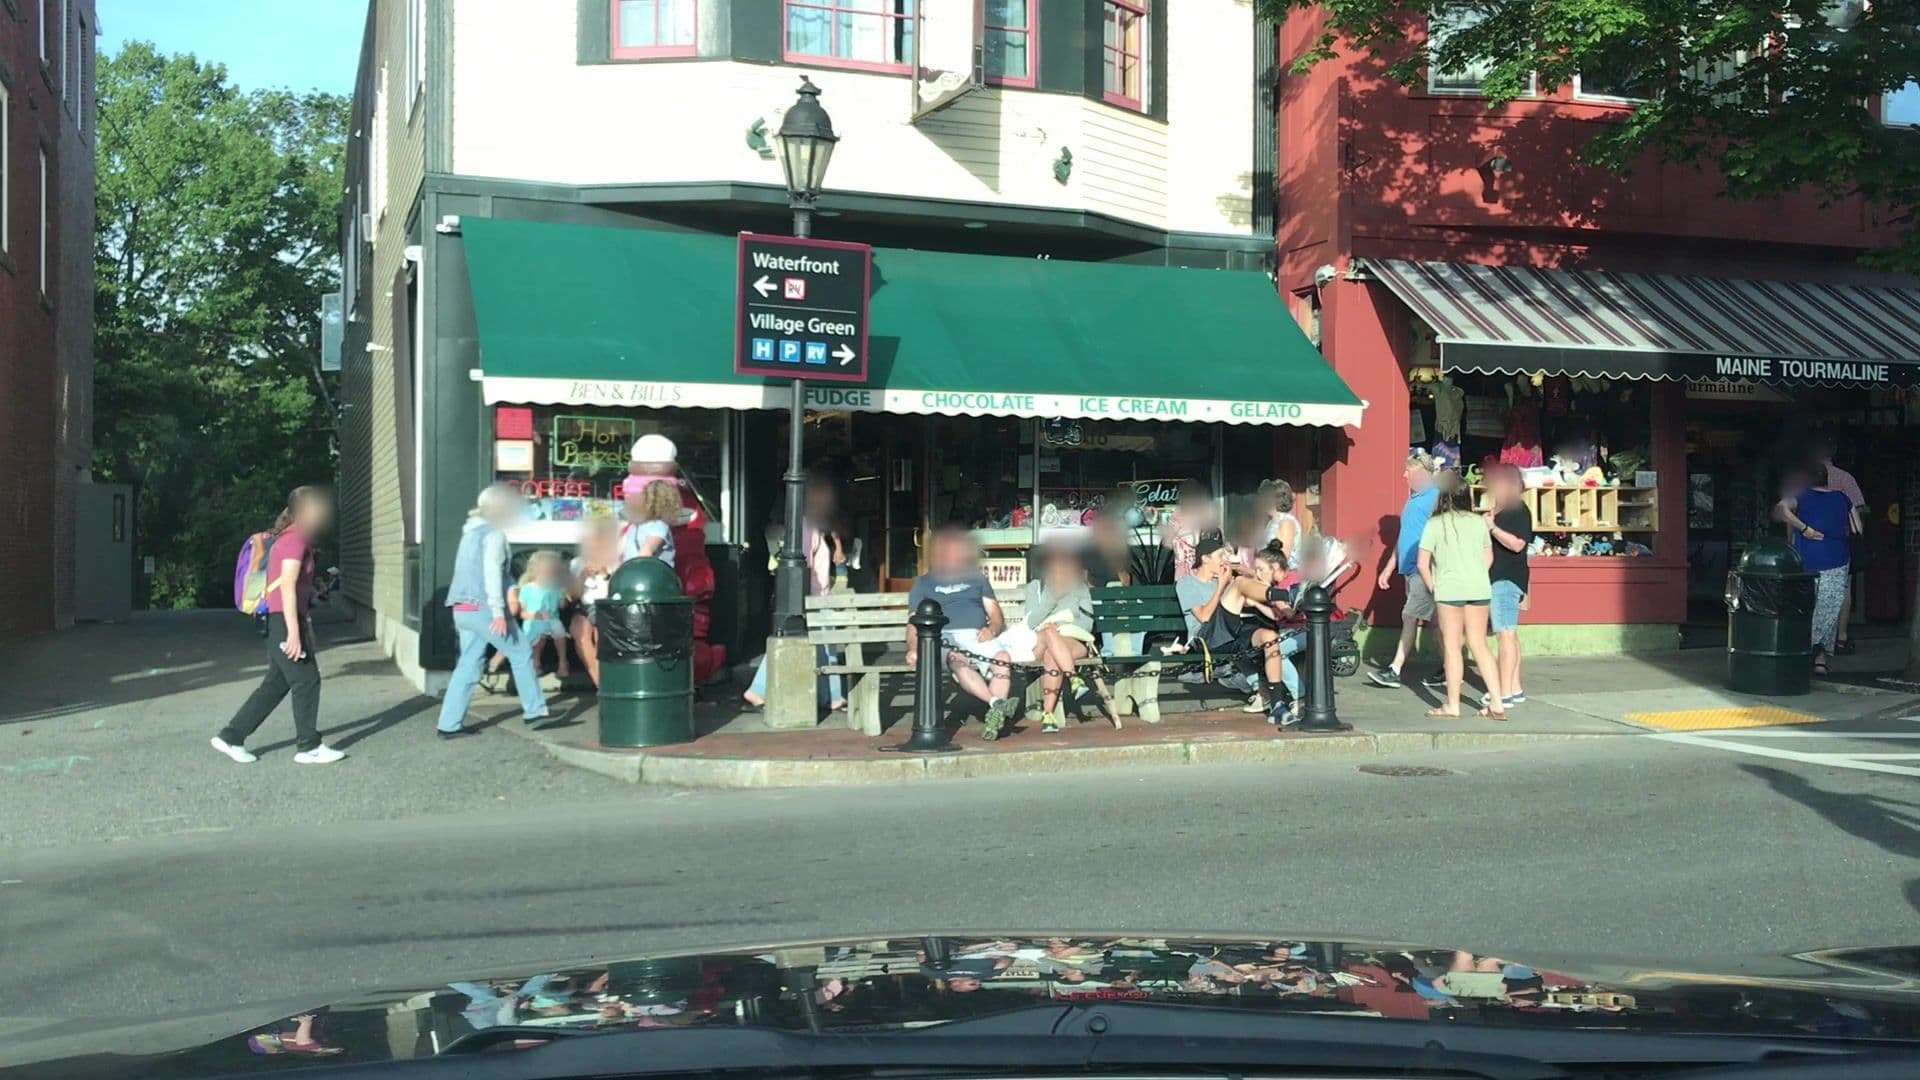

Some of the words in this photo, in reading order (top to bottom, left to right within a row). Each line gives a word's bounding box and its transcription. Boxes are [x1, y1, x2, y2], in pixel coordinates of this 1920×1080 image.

[752, 252, 840, 275] Waterfront
[749, 313, 805, 335] Village
[808, 317, 855, 336] Green
[756, 341, 771, 358] H
[785, 344, 797, 359] P
[807, 346, 825, 360] RV
[1715, 357, 1772, 377] MAINE
[1779, 360, 1889, 382] TOURMALINE
[570, 382, 606, 399] BEN
[611, 383, 625, 400] &
[803, 389, 871, 407] FUDGE
[921, 392, 1034, 411] CHOCOLATE
[1079, 397, 1108, 413] ICE
[1118, 398, 1188, 415] CREAM
[1230, 402, 1301, 418] GELATO
[572, 419, 618, 444] Hot
[561, 441, 633, 465] Pretzels
[508, 479, 592, 499] OFFEE
[1133, 483, 1182, 512] Gelat
